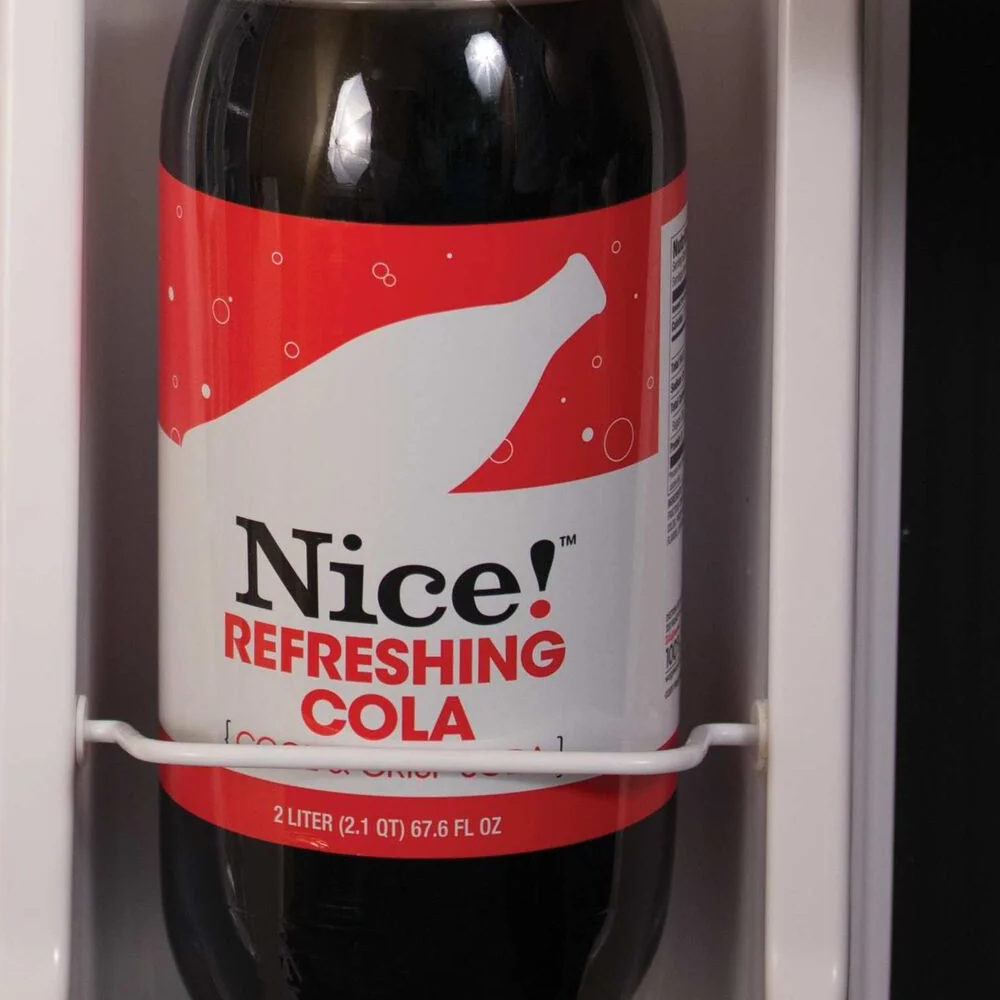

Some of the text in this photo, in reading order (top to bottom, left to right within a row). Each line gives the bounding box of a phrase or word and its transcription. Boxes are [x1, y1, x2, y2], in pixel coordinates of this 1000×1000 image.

[235, 515, 555, 627] Nice!
[224, 612, 566, 686] REFRESHING
[301, 688, 475, 742] COLA
[273, 805, 502, 841] 2 LITER (2.1 QT) 67.6 FL OZ
